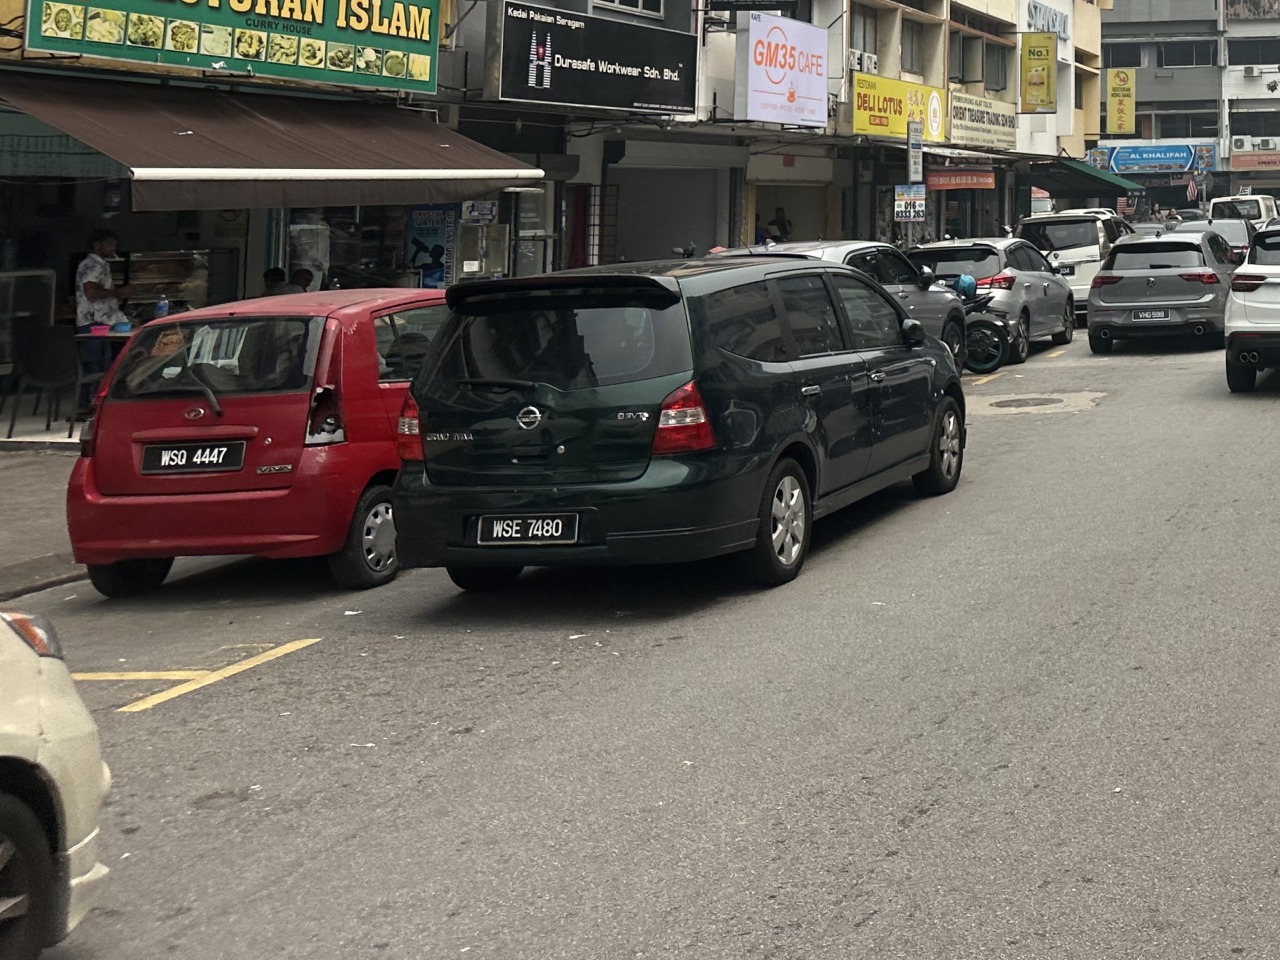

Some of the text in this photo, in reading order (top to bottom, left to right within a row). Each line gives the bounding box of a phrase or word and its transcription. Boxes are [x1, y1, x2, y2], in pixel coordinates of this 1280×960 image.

[245, 18, 312, 35] CURRY HOUSE
[508, 7, 585, 29] Kedai Pakaian Seragam
[754, 39, 823, 76] GM35 CAFE
[1028, 49, 1049, 57] No.1
[554, 54, 595, 71] Durasafe
[598, 60, 641, 77] Workwear
[643, 66, 661, 79] Sdn.
[663, 68, 680, 81] Bhd.
[857, 92, 875, 112] DELI
[877, 96, 902, 116] LOTUS
[904, 201, 916, 210] 016
[161, 447, 227, 466] WSQ 4447
[257, 464, 292, 474] VIVA
[493, 519, 562, 538] WSE 7480
